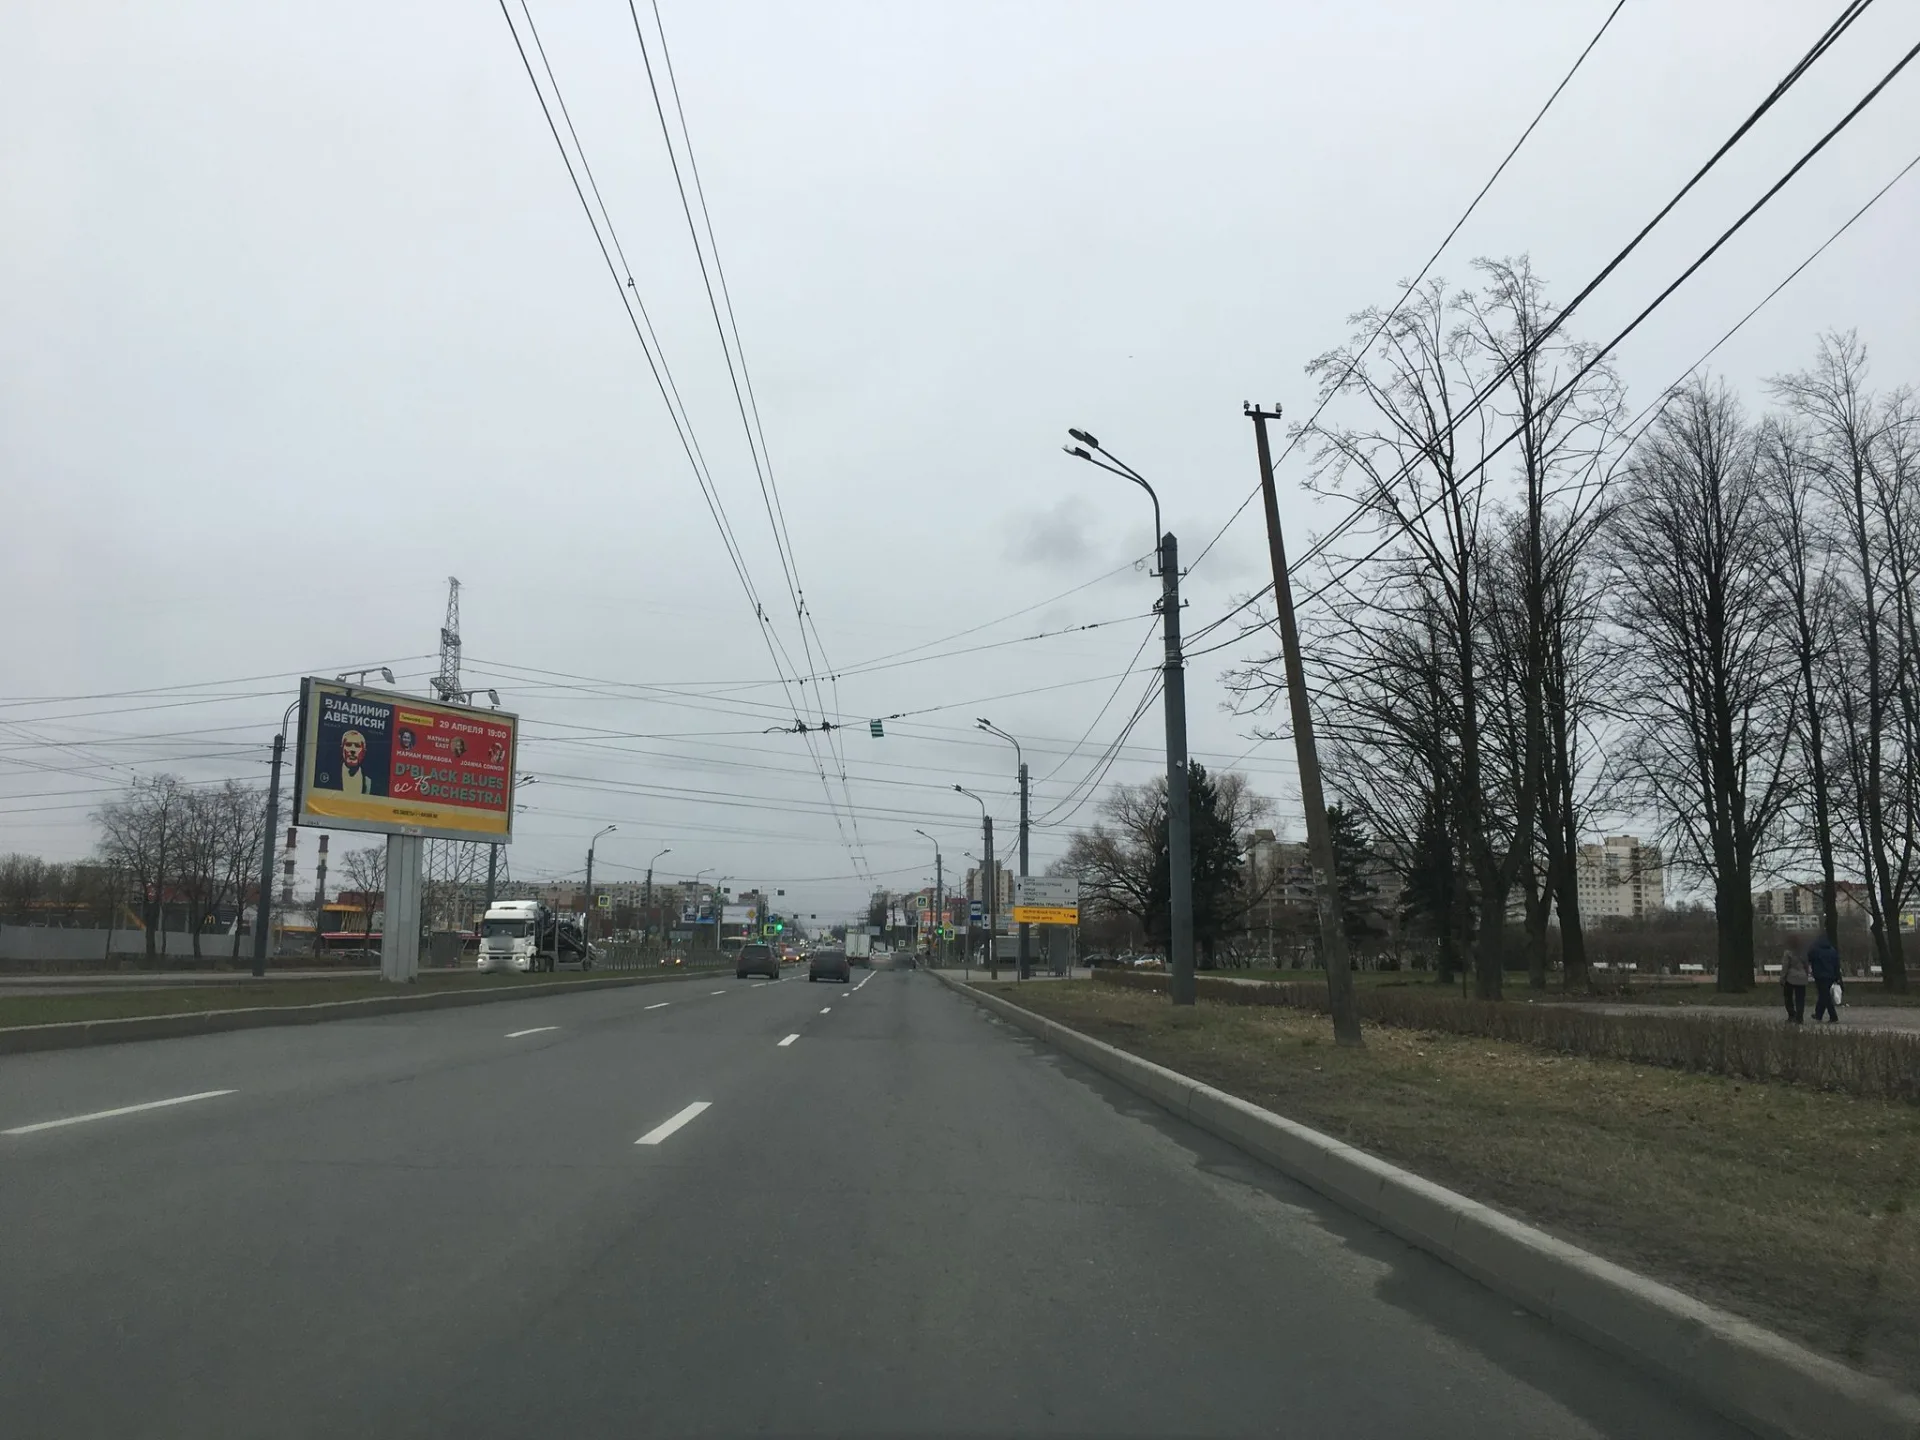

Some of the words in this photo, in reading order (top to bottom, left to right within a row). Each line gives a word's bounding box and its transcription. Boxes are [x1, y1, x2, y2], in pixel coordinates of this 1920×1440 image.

[325, 698, 390, 718] ВЛАДИМИР
[324, 711, 386, 730] АВЕТИСЯН
[439, 720, 450, 729] 29
[451, 722, 484, 735] АПРЕЛЯ
[487, 728, 507, 739] 19:00
[462, 772, 504, 790] BLUES
[420, 782, 503, 805] ORCHESTRA
